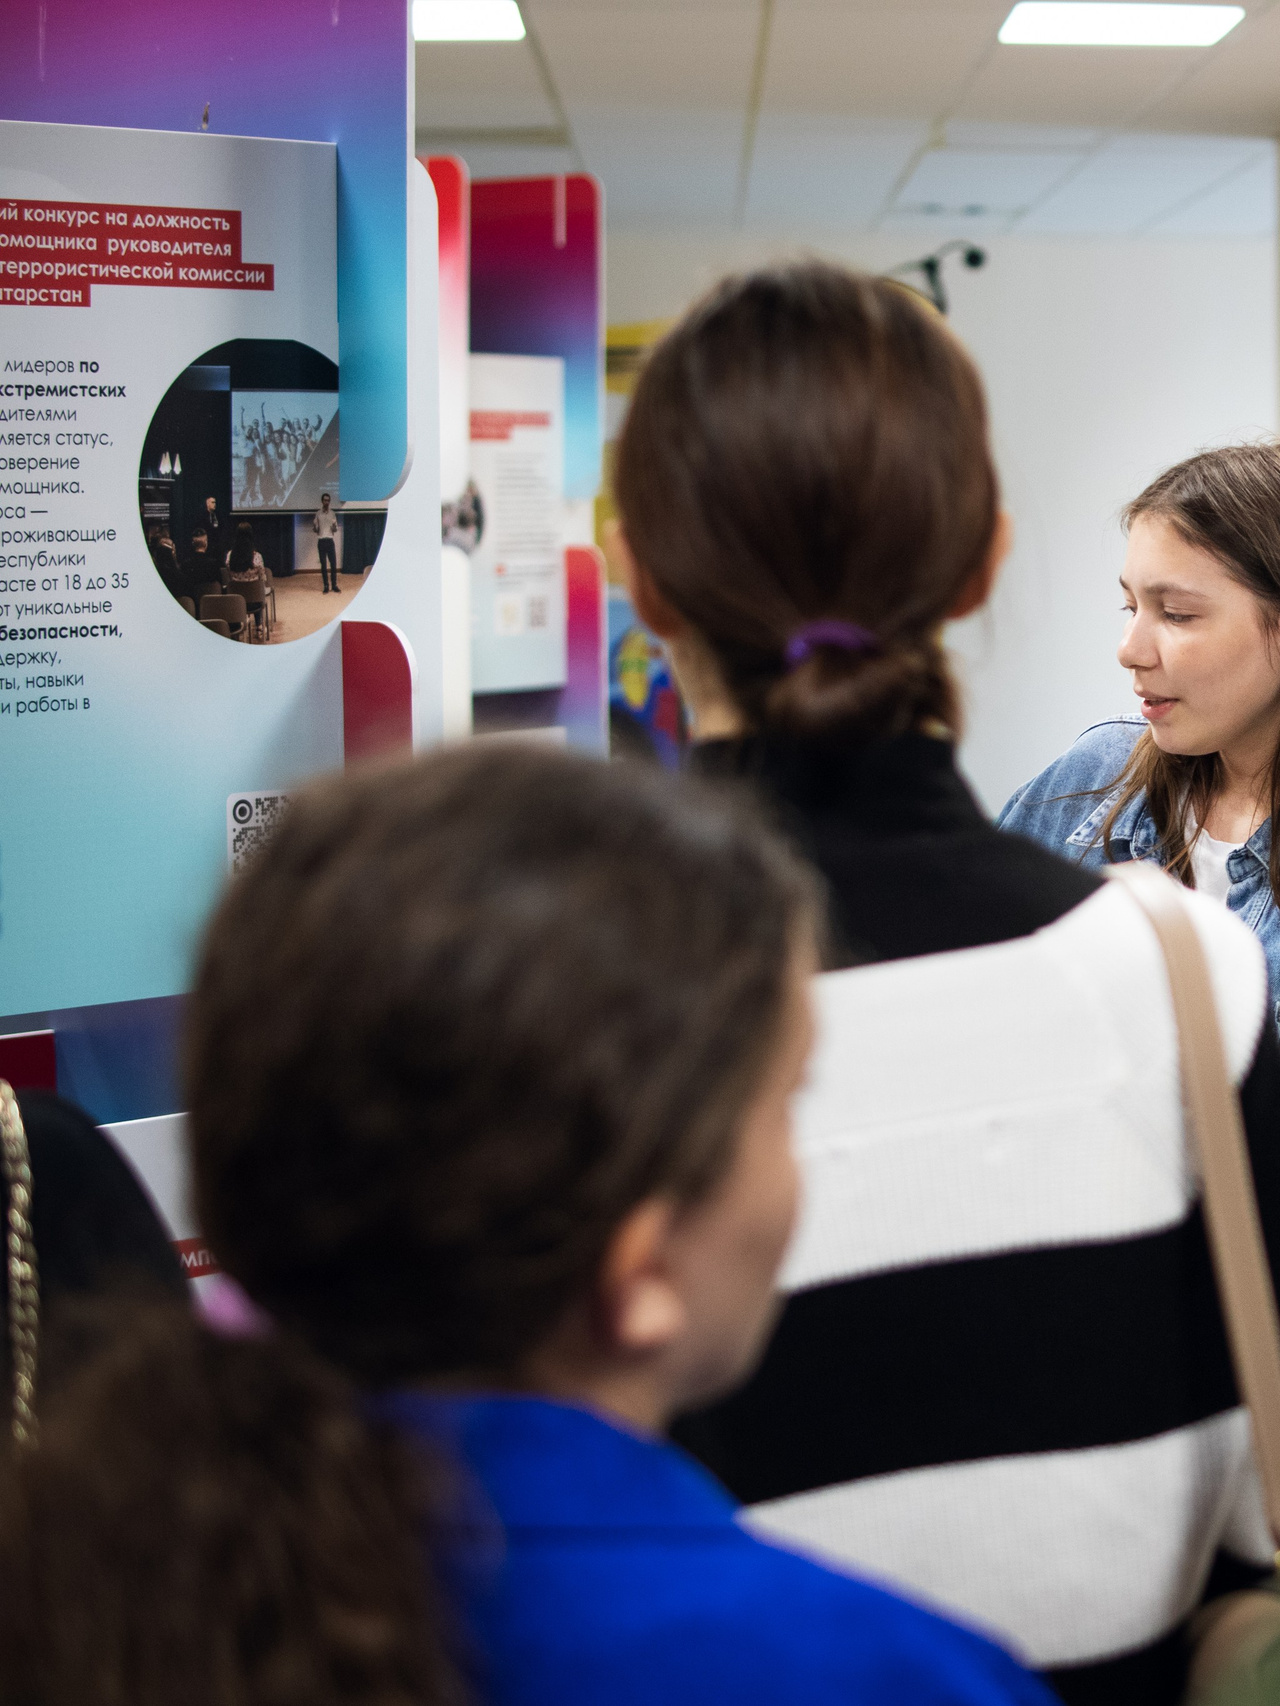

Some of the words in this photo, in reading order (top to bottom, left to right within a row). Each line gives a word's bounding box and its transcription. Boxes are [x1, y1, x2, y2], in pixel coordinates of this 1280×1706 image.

[24, 208, 100, 228] конкурс
[105, 212, 128, 226] на
[132, 213, 231, 231] должность
[0, 234, 97, 251] омощника
[107, 238, 232, 256] руководителя
[179, 267, 265, 284] комиссии
[0, 287, 82, 305] тарстан
[4, 360, 75, 376] лидеров
[79, 361, 100, 373] по
[55, 432, 114, 449] статус,
[0, 481, 85, 495] мощника.
[1, 528, 117, 547] роживающие
[41, 578, 59, 591] от
[65, 573, 82, 590] 18
[86, 577, 107, 591] до
[111, 572, 130, 589] 35
[15, 600, 113, 620] уникальные
[0, 624, 123, 641] безопасности,
[25, 674, 84, 689] навыки
[1, 702, 11, 714] и
[16, 695, 78, 717] работы
[83, 697, 91, 710] в
